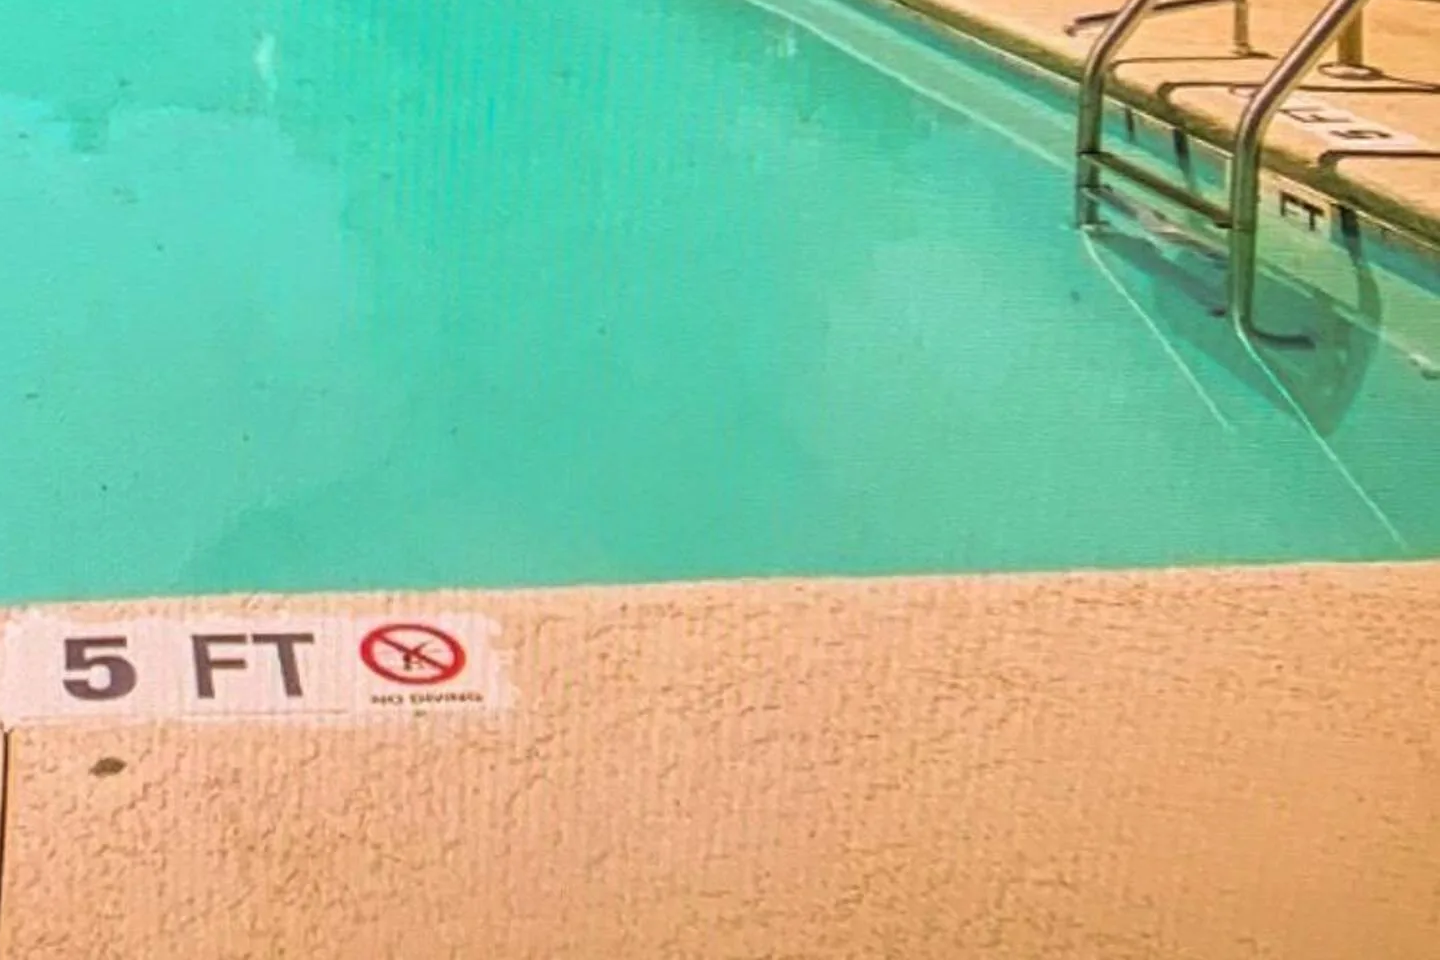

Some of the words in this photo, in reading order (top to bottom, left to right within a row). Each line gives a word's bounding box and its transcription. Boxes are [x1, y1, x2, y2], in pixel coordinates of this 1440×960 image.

[62, 635, 138, 702] 5
[190, 632, 315, 698] FT
[370, 693, 404, 707] NO
[409, 691, 484, 705] DIVING
